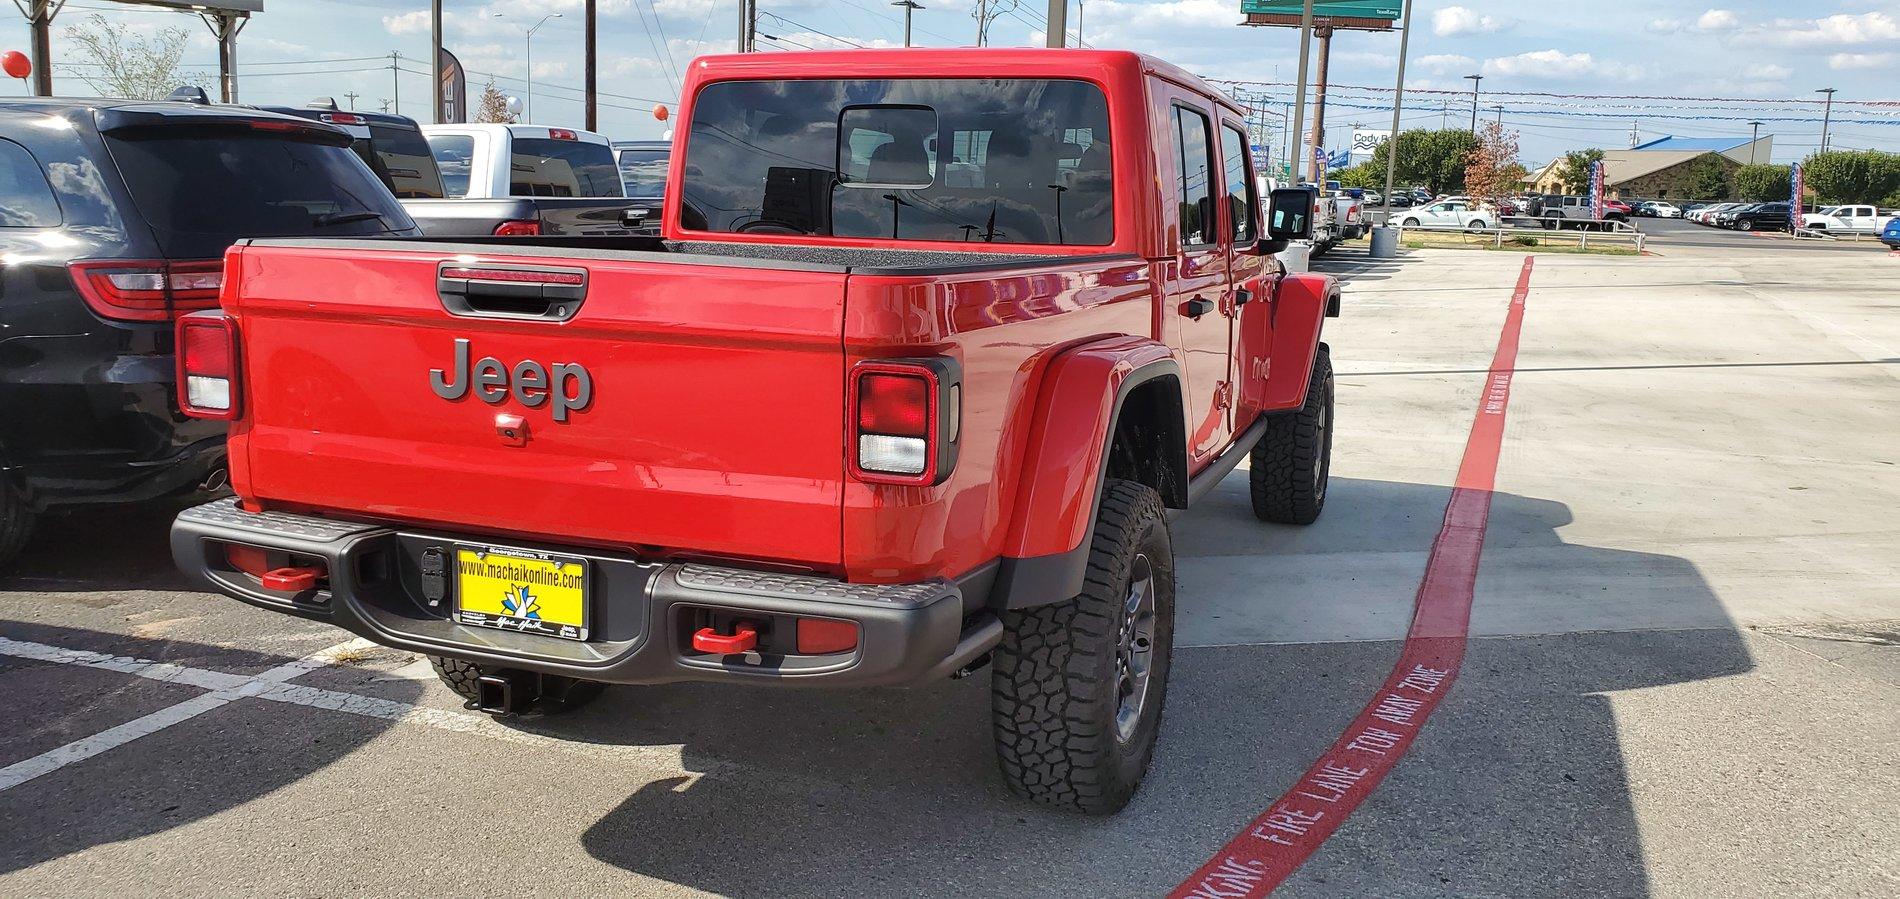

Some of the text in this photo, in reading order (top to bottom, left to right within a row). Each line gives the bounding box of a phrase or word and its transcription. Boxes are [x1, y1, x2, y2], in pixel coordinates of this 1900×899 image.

[1354, 133, 1379, 143] Cody
[429, 337, 594, 422] Jeep
[458, 559, 583, 590] www.machaikonline.com
[1396, 663, 1450, 694] ZONE
[1370, 693, 1424, 727] AWAY
[1296, 759, 1369, 803] LANE
[1251, 801, 1325, 846] FIRE
